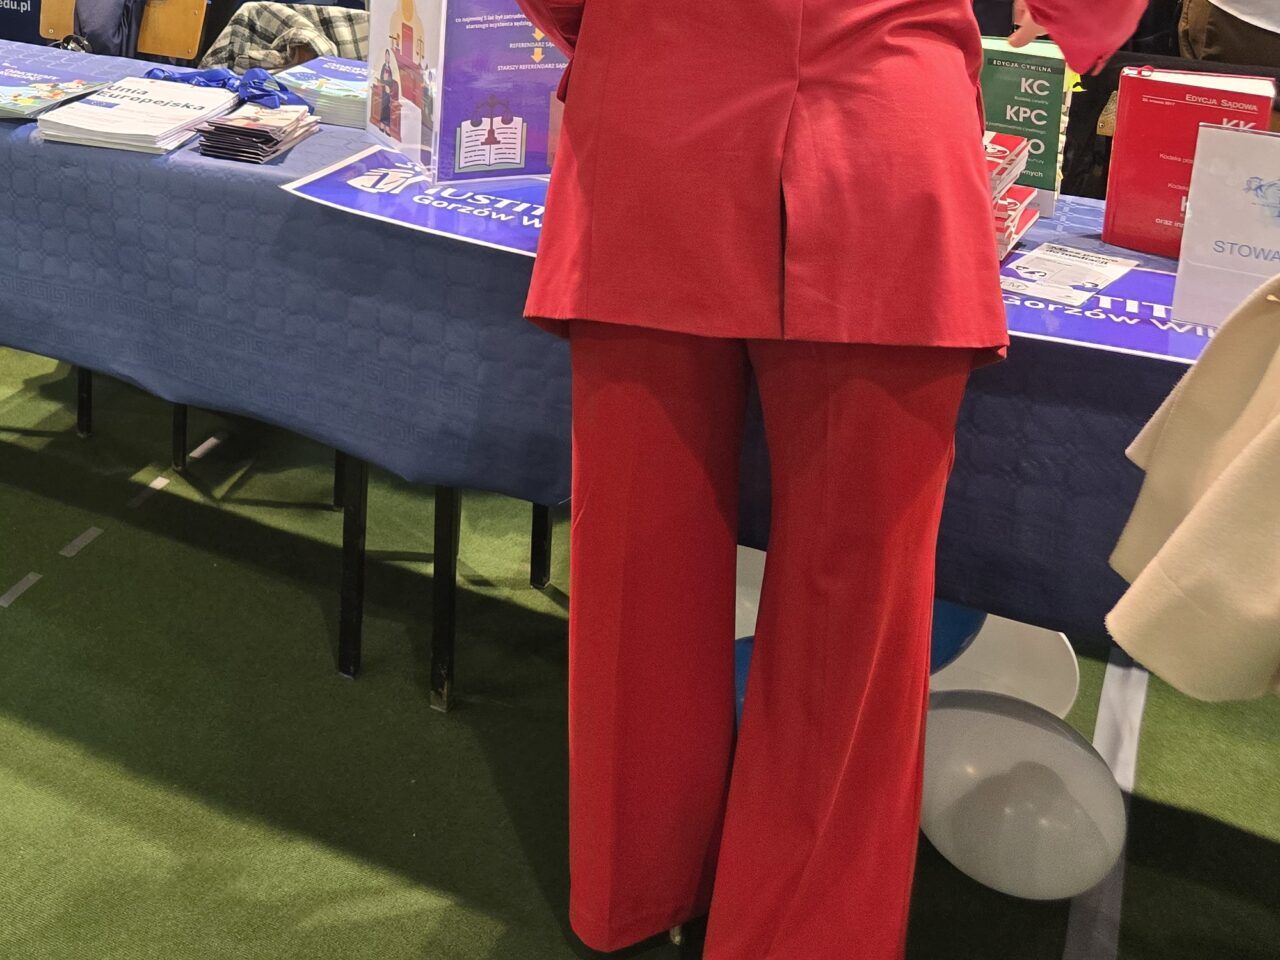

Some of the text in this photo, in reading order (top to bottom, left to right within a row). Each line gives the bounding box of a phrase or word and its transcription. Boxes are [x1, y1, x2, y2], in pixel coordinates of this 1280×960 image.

[992, 59, 1052, 73] EDYCJA CYWILNA
[106, 84, 149, 96] Unia
[1020, 77, 1051, 96] KC
[96, 88, 207, 112] Europejska
[1185, 93, 1218, 106] EDYCJA
[1220, 99, 1259, 111] SĄDOWA
[1005, 104, 1048, 126] KPC
[412, 194, 516, 222] Gorzów
